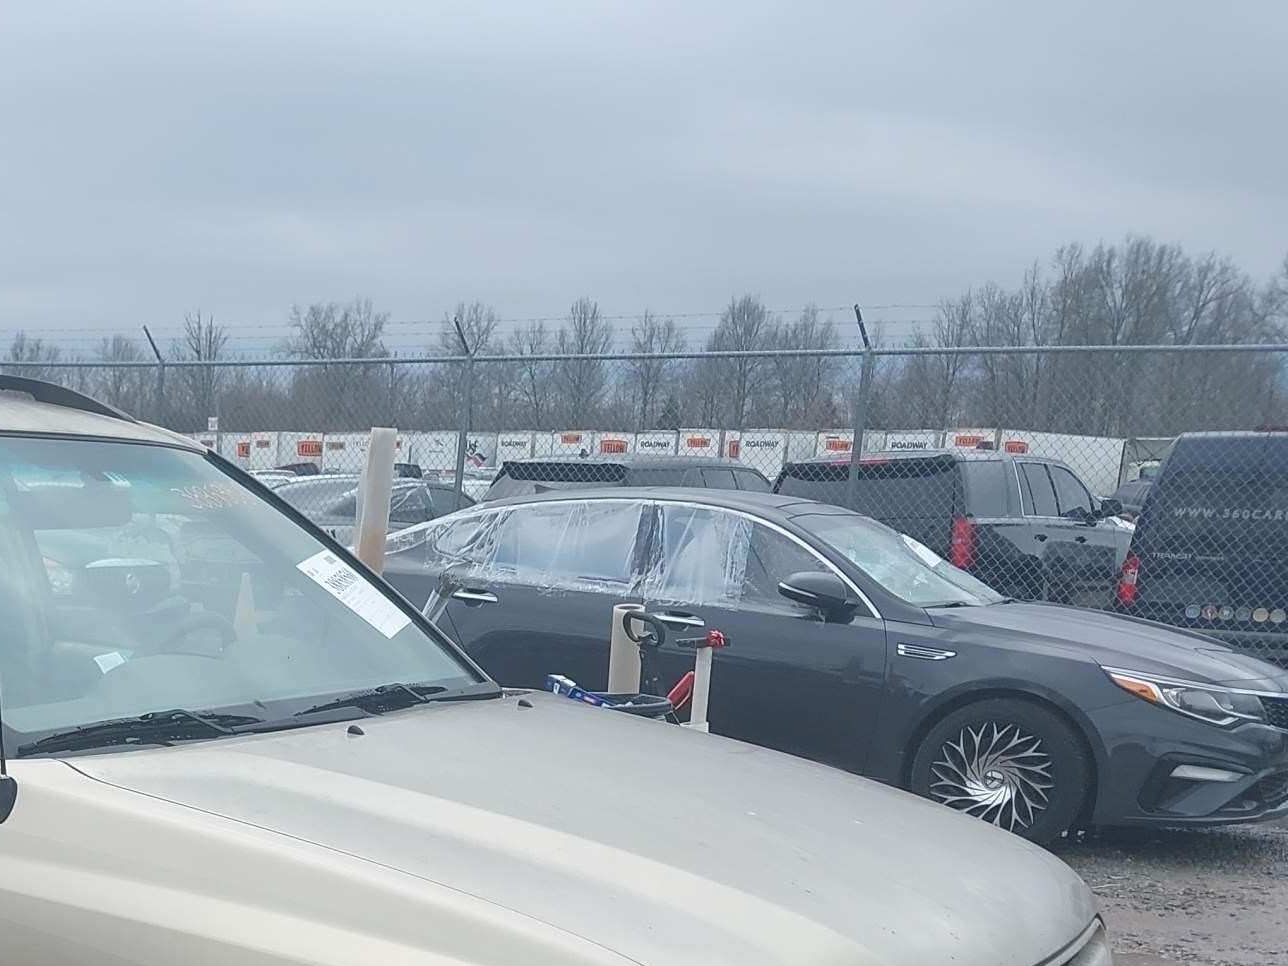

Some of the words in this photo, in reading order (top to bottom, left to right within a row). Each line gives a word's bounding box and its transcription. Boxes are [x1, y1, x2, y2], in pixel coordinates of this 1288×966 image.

[640, 441, 671, 449] ROADWAY
[745, 440, 780, 449] ROADWAY
[891, 441, 929, 450] ROADWAY
